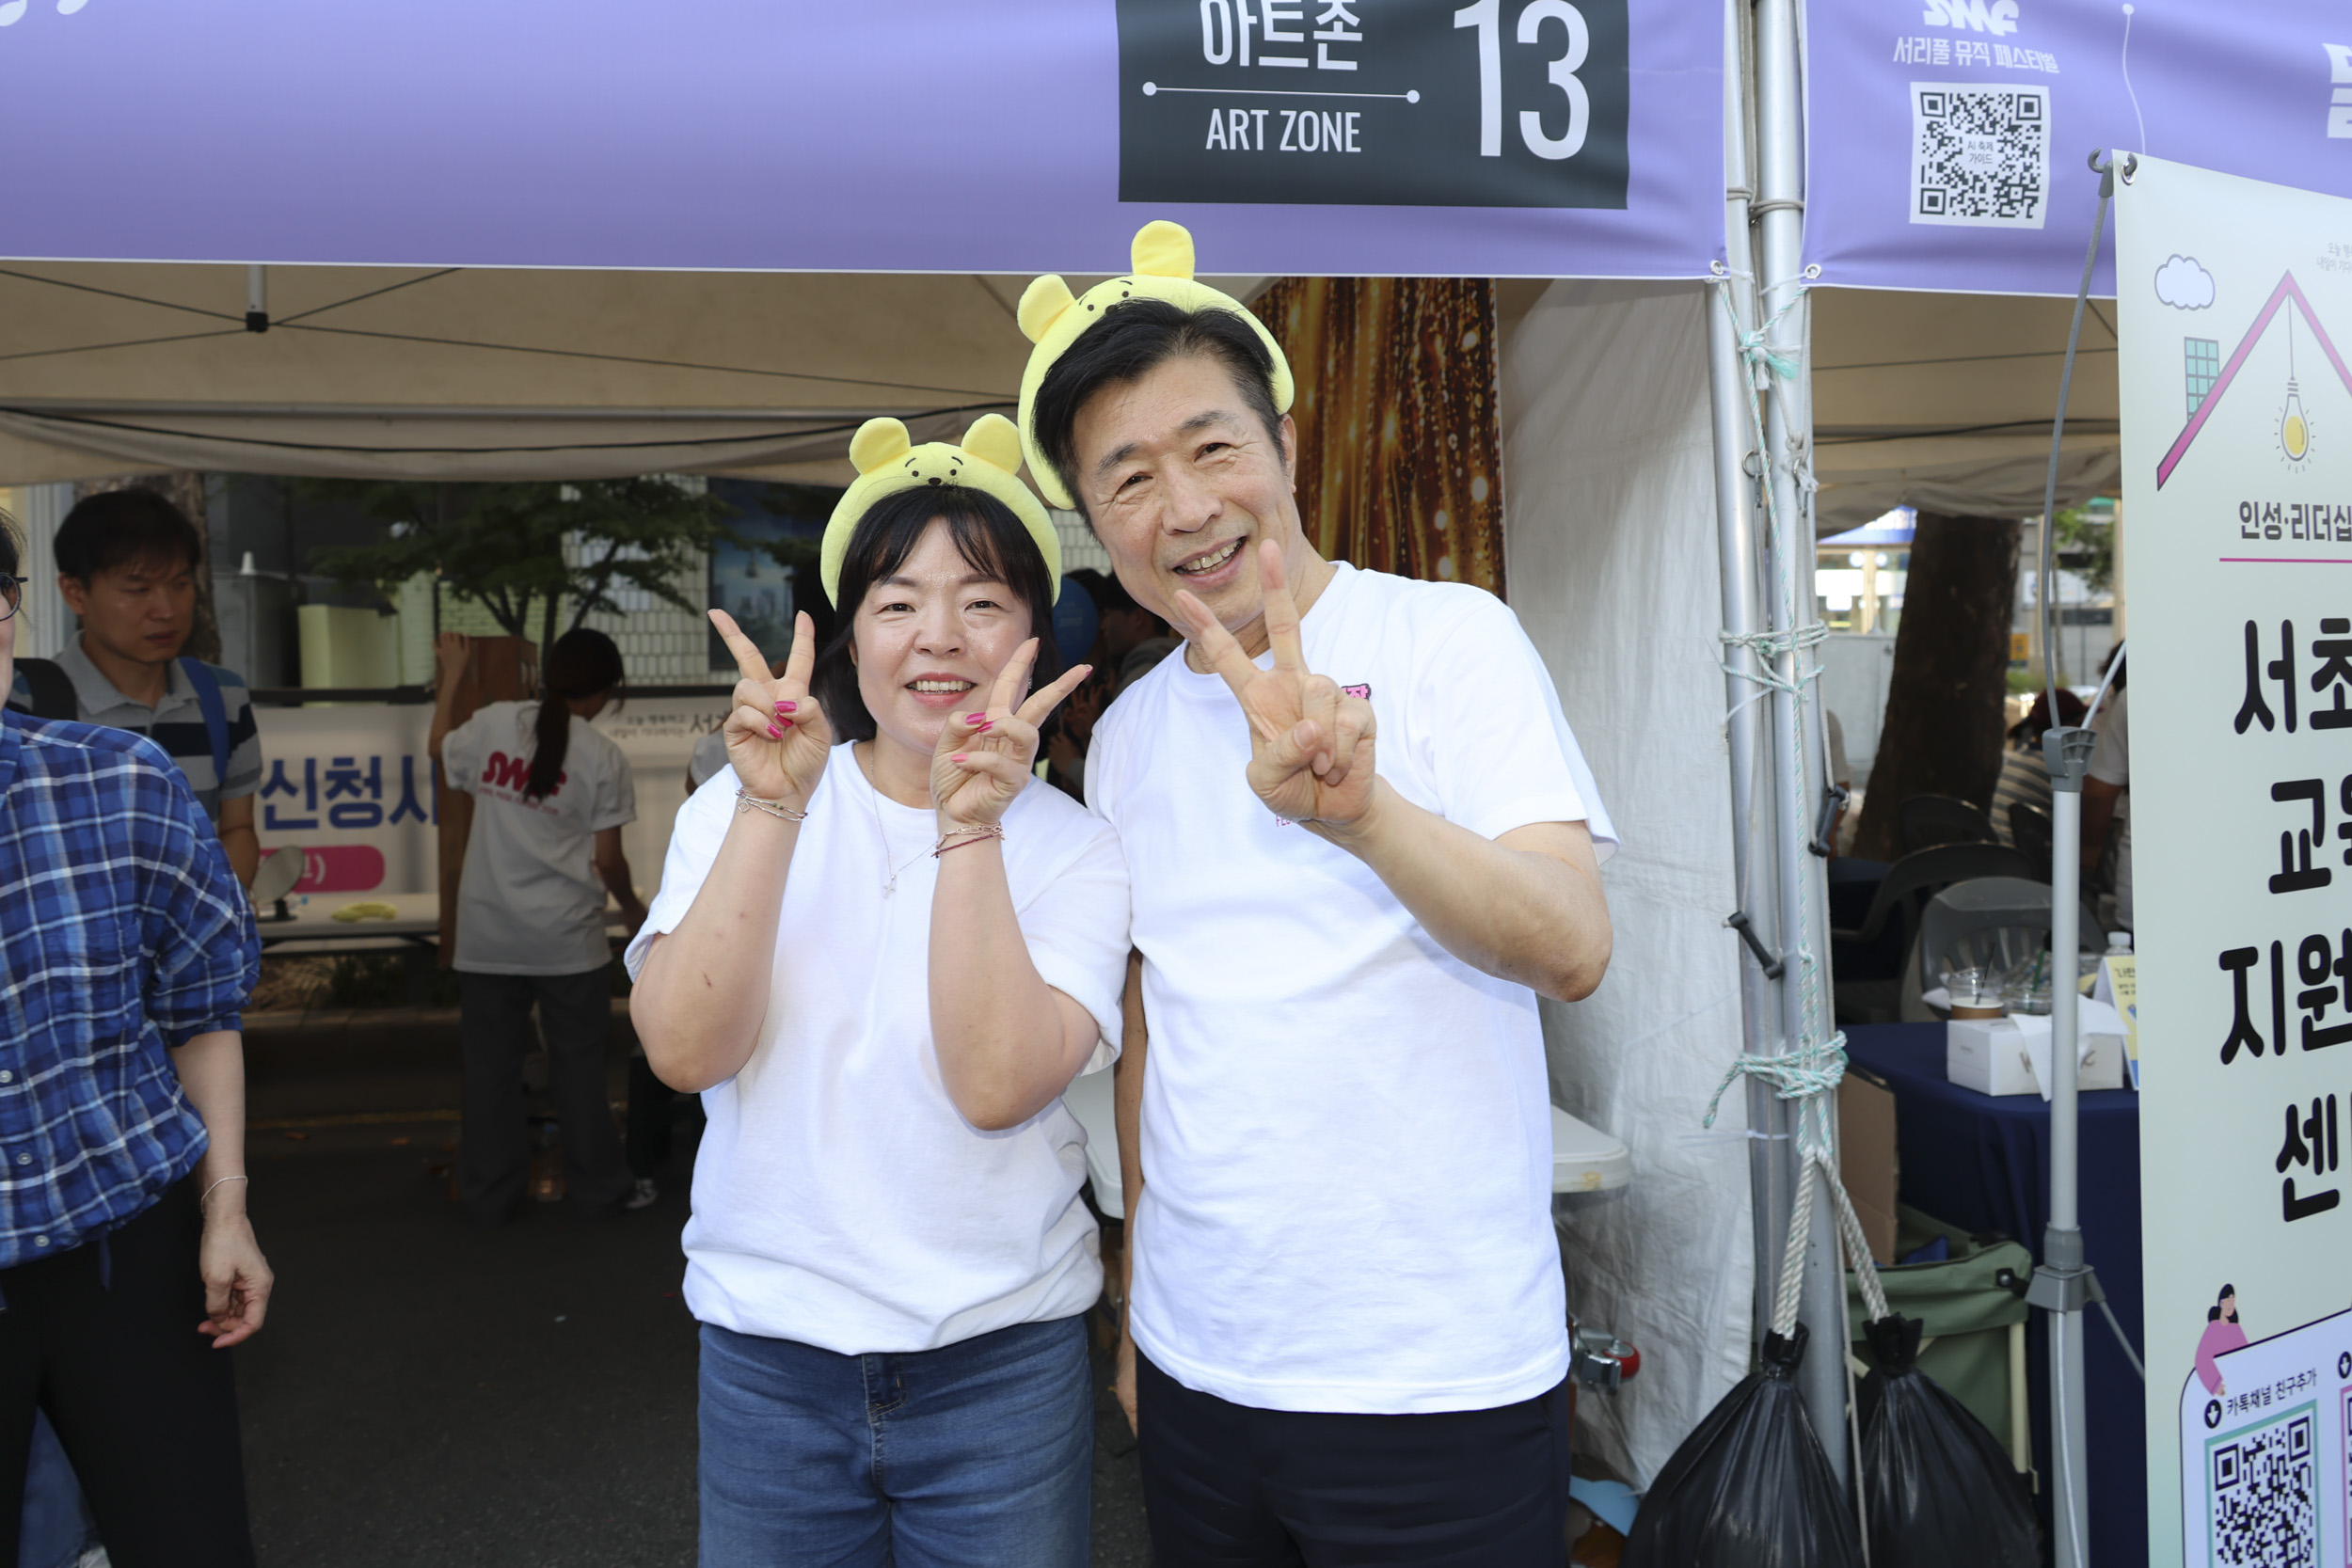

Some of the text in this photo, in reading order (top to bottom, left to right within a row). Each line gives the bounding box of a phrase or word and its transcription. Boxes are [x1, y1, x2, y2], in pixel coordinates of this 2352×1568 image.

[1200, 0, 1363, 71] 아트존
[1893, 37, 2060, 73] 서리풀 뮤직 페스티벌
[1454, 0, 1590, 160] 13
[1205, 108, 1362, 153] ART ZONE
[1969, 153, 1994, 165] 가이드
[2233, 617, 2352, 735] 서초
[482, 750, 568, 798] SM
[2218, 927, 2352, 1065] 지원
[2276, 1091, 2352, 1223] 센
[2227, 1368, 2317, 1417] 카톡채널 친구추가
